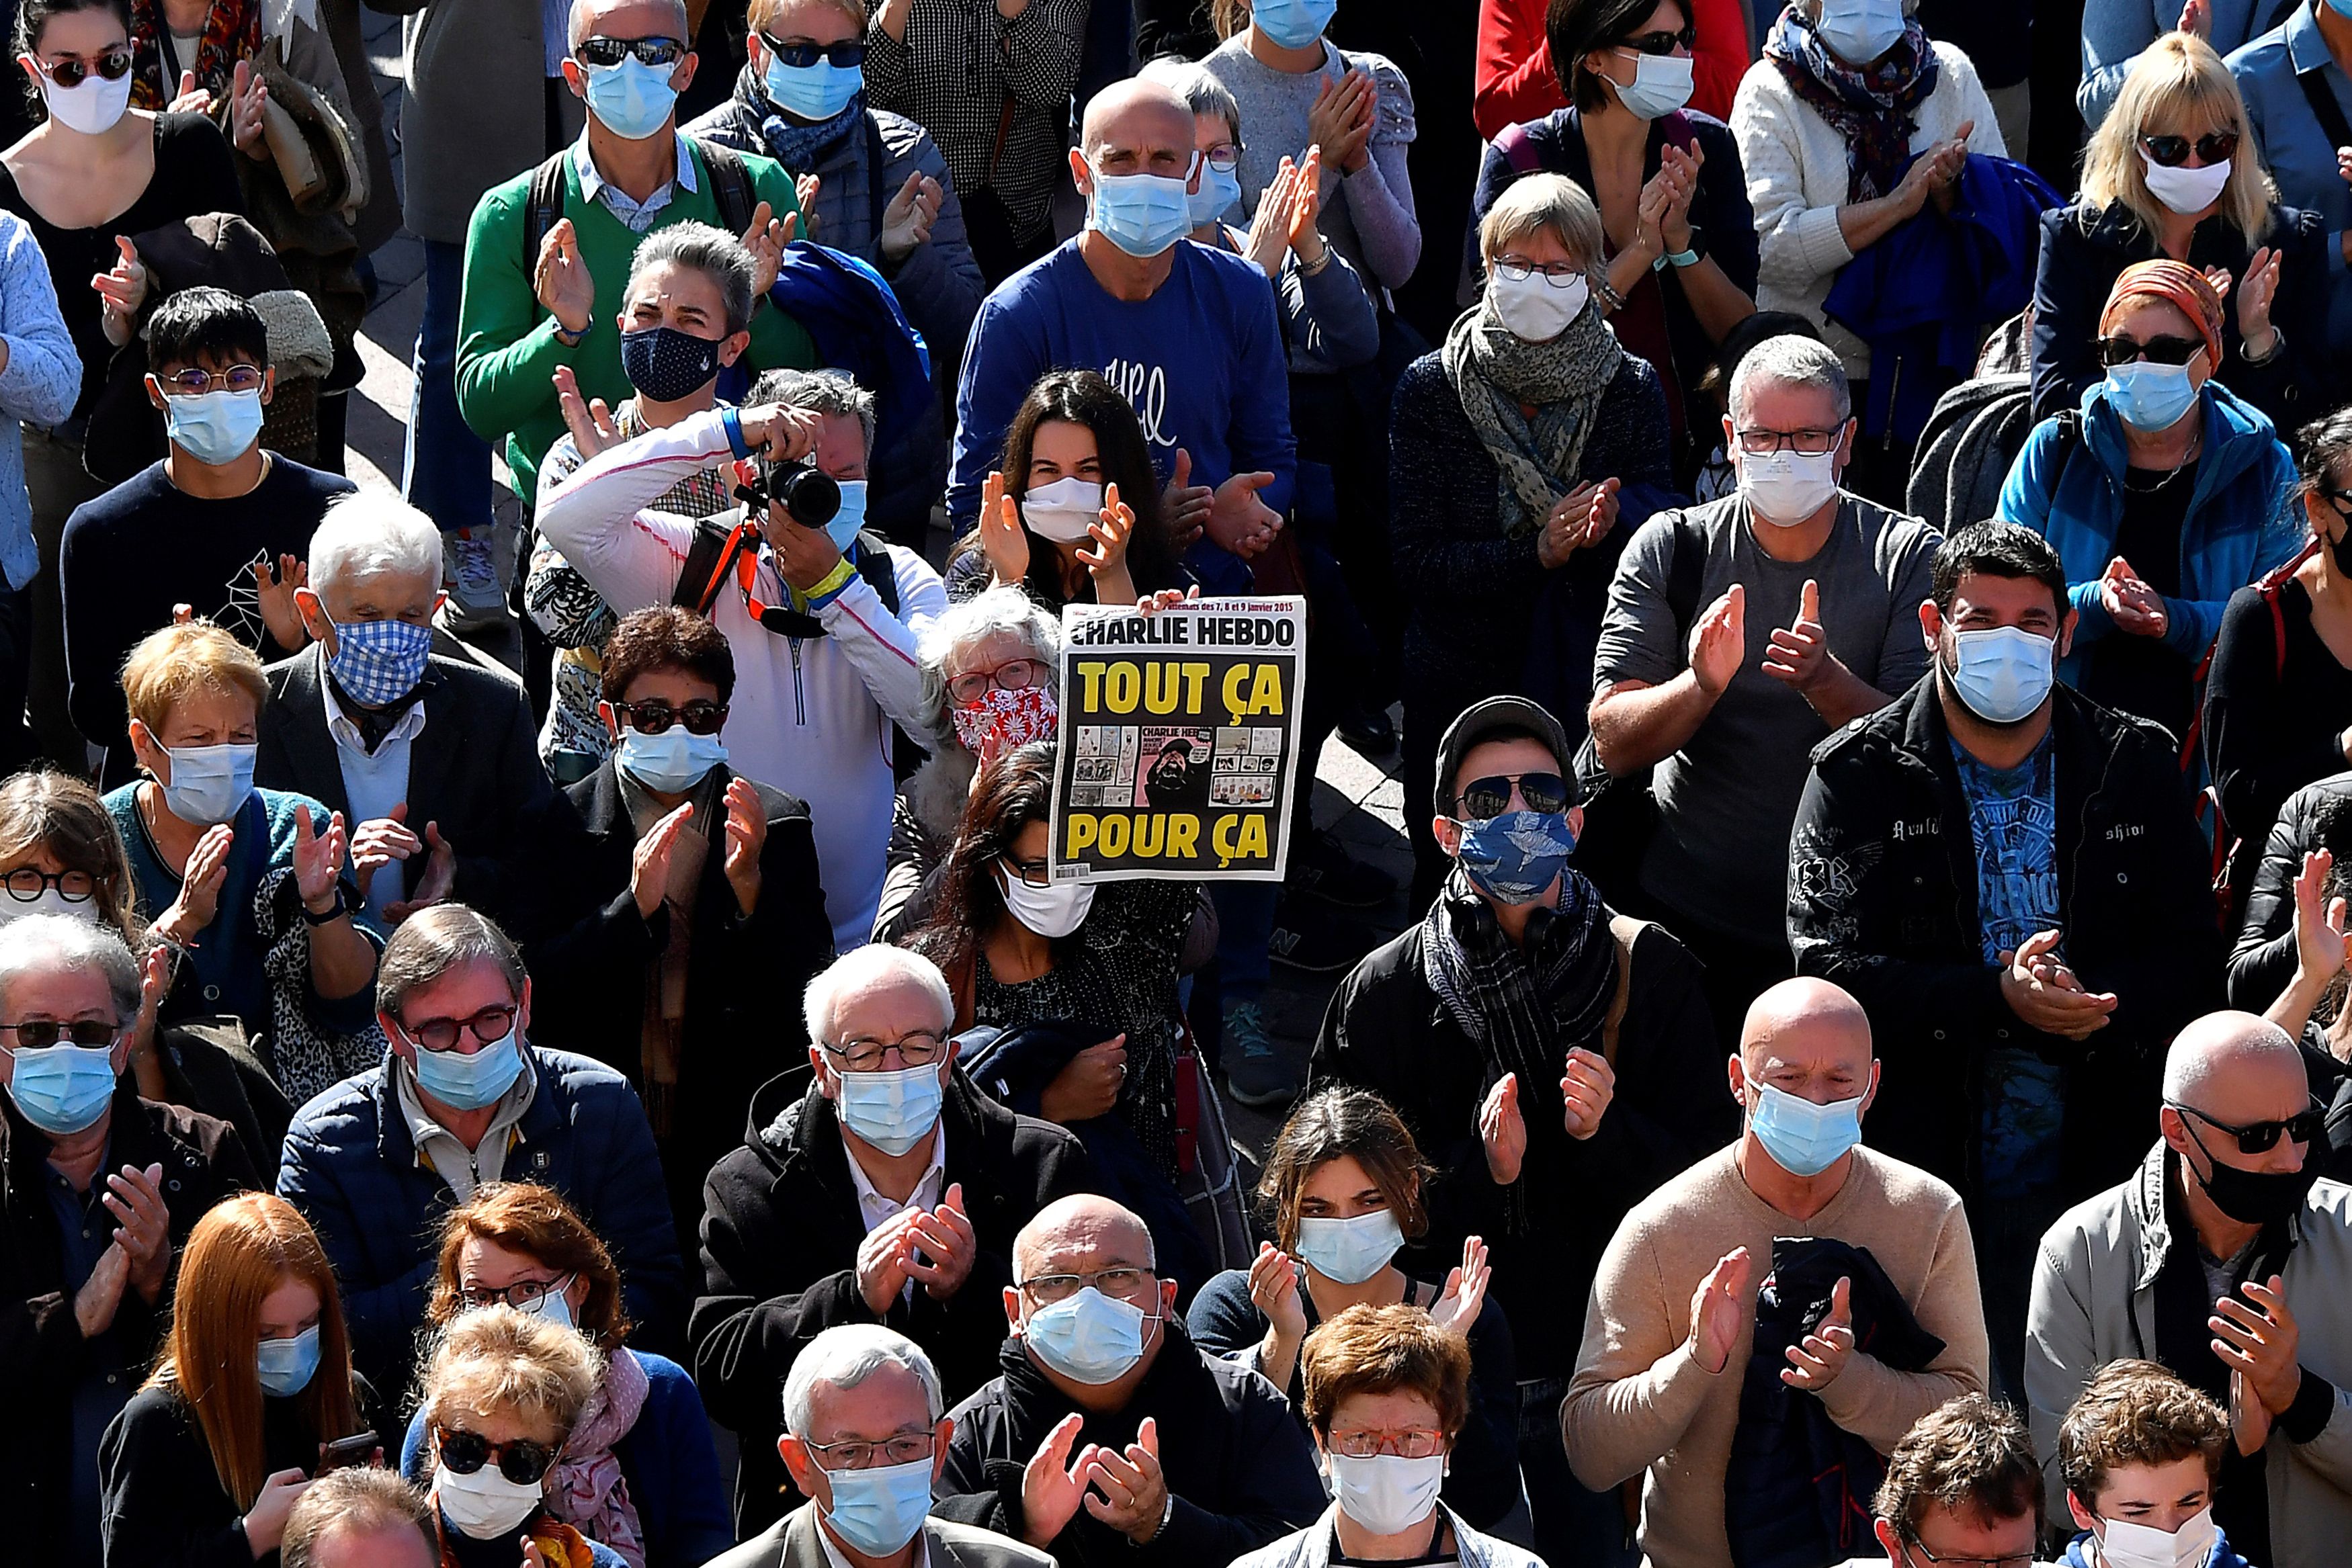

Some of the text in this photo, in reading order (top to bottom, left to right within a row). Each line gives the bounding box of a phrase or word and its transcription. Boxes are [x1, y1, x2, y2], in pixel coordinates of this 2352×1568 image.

[1202, 602, 1214, 611] des
[1216, 603, 1223, 612] 7,
[1225, 603, 1230, 611] 8
[1232, 603, 1239, 611] et
[1241, 603, 1245, 611] 9
[1248, 603, 1273, 612] janvier
[1274, 603, 1294, 612] 2015
[1070, 617, 1295, 646] CHARLIE HEBDO
[1077, 661, 1284, 726] TOUT ÇA
[1142, 727, 1180, 737] CHARLIE
[1066, 814, 1269, 869] POUR ÇA
